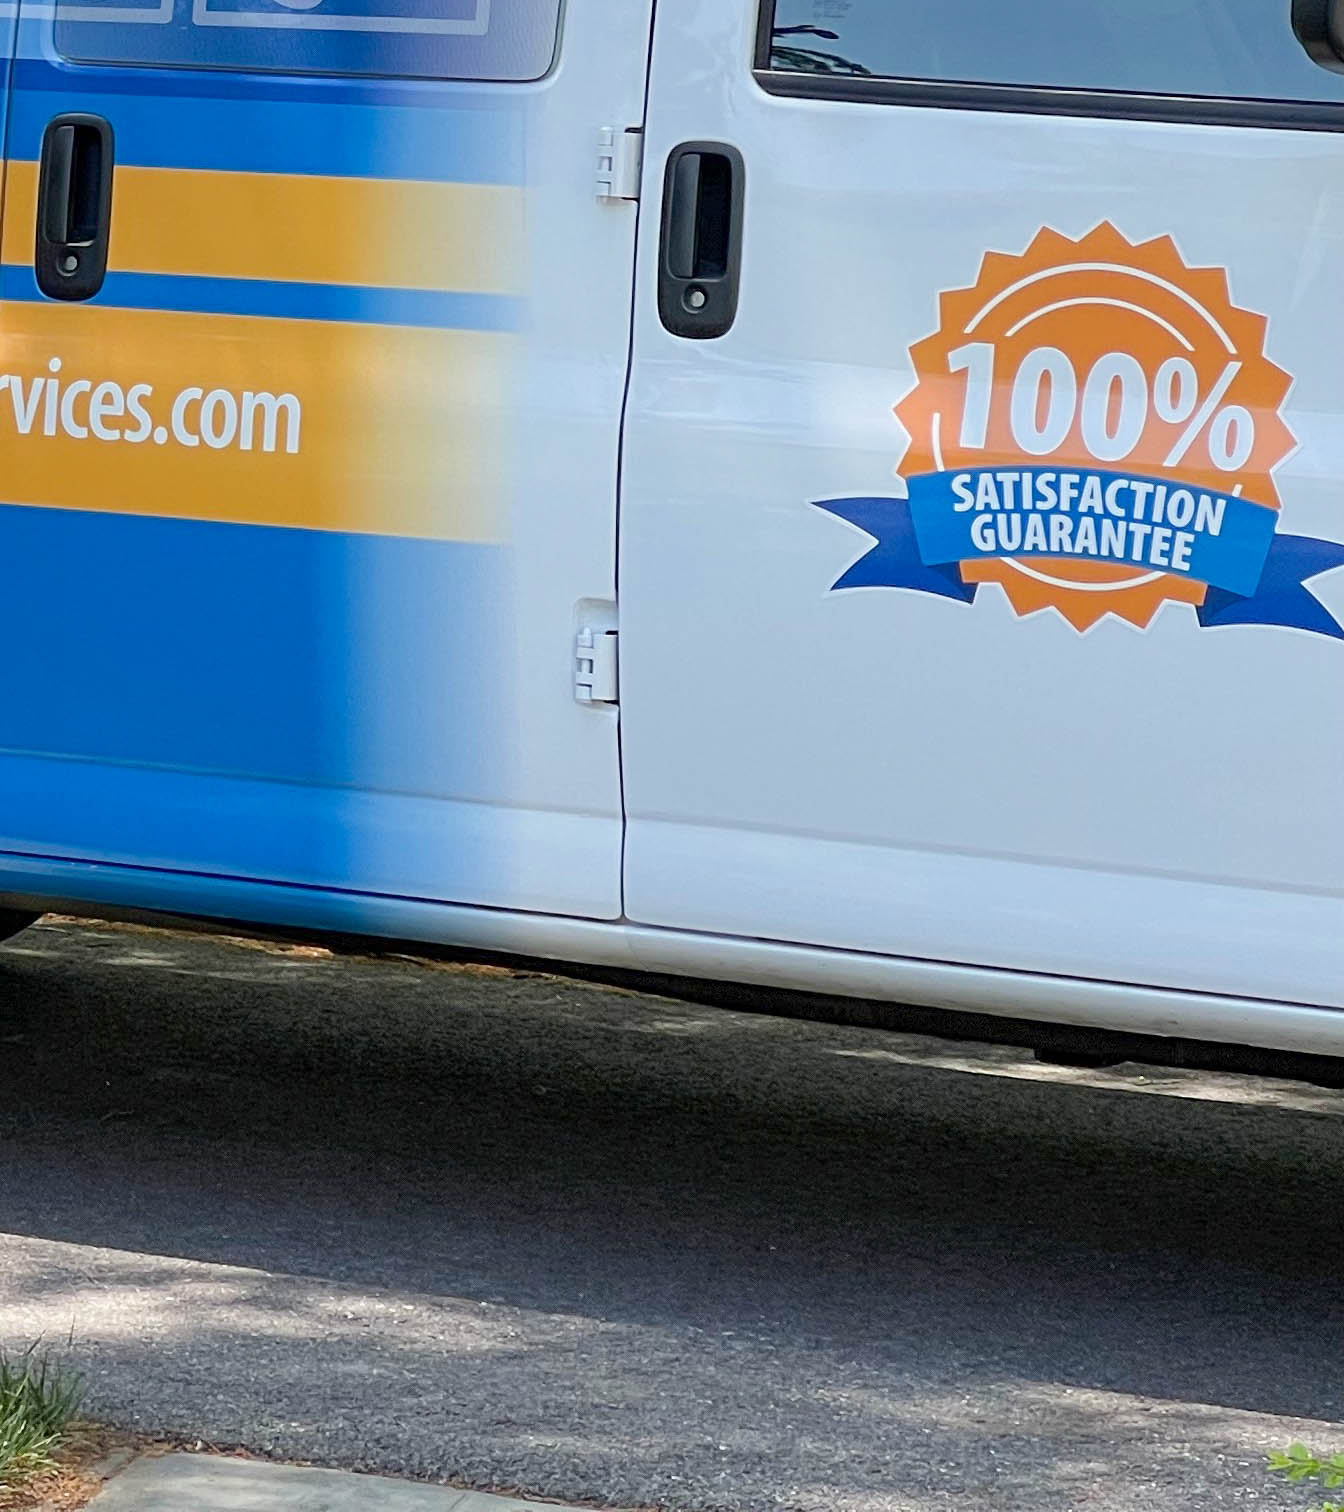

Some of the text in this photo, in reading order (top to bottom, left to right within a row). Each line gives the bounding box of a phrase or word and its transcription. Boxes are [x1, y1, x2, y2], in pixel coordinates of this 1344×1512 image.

[946, 341, 1255, 472] 100%
[949, 471, 1227, 537] SATISFACTION
[970, 512, 1196, 572] GUARANTEE
